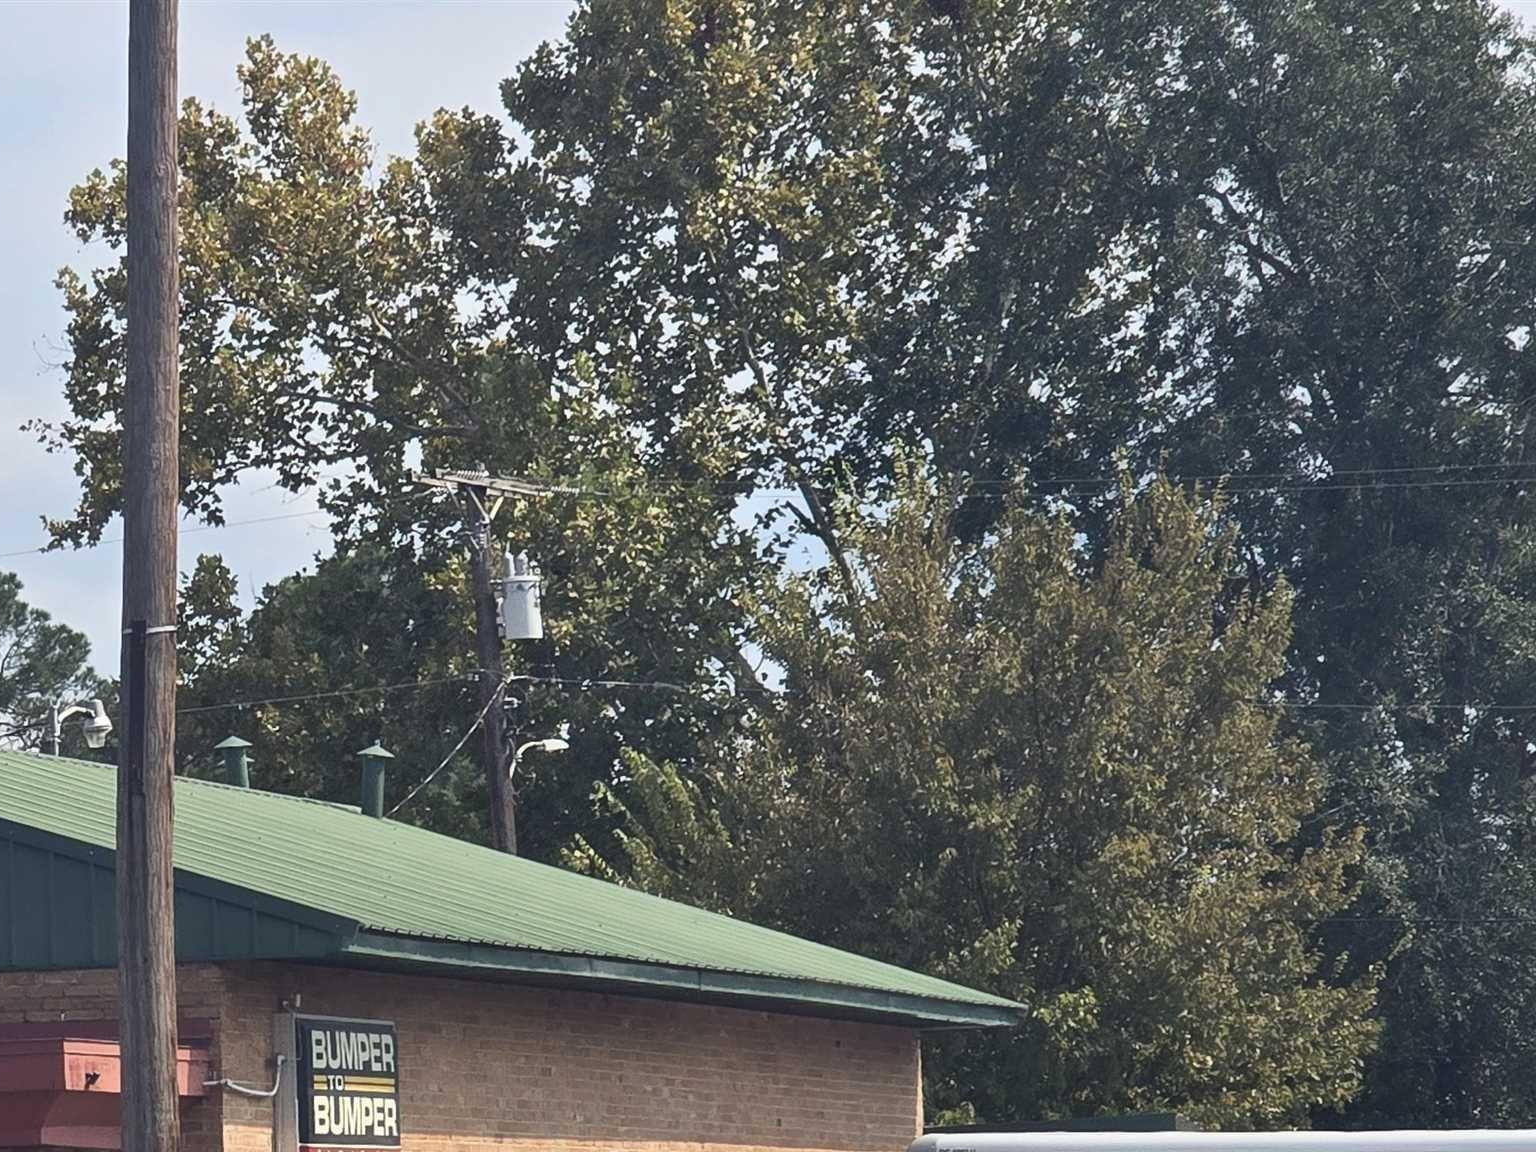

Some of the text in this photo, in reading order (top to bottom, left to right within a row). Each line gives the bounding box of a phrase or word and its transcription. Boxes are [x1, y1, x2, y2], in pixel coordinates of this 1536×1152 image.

[311, 1030, 395, 1073] BUMPER
[328, 1075, 344, 1091] TO
[314, 1095, 398, 1137] BUMPER
